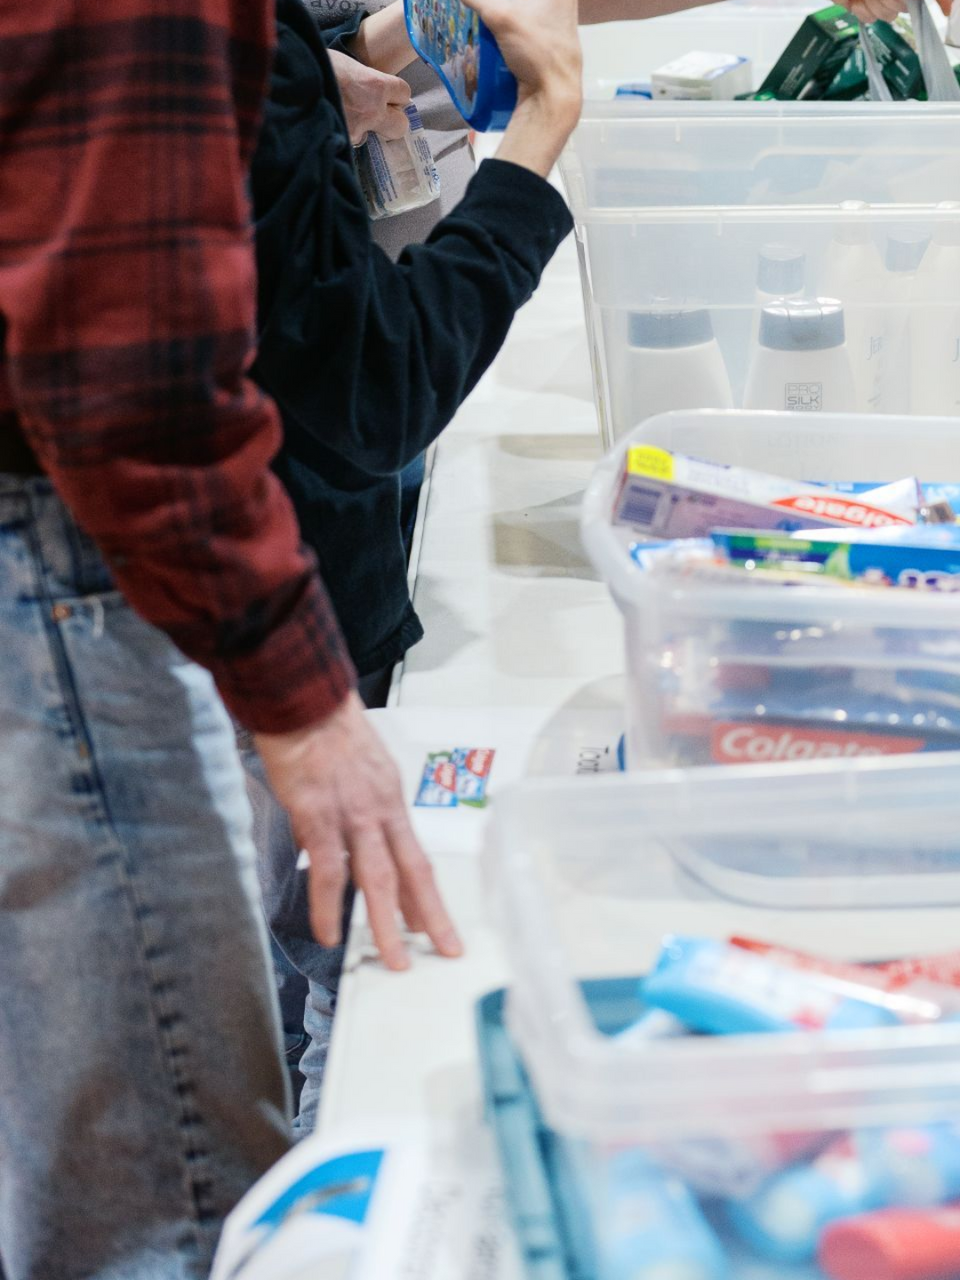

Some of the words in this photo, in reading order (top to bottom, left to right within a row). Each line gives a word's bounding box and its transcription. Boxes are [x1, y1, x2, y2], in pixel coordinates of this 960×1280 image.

[787, 384, 821, 395] PRO
[787, 396, 820, 406] SILK
[796, 494, 911, 528] olgate
